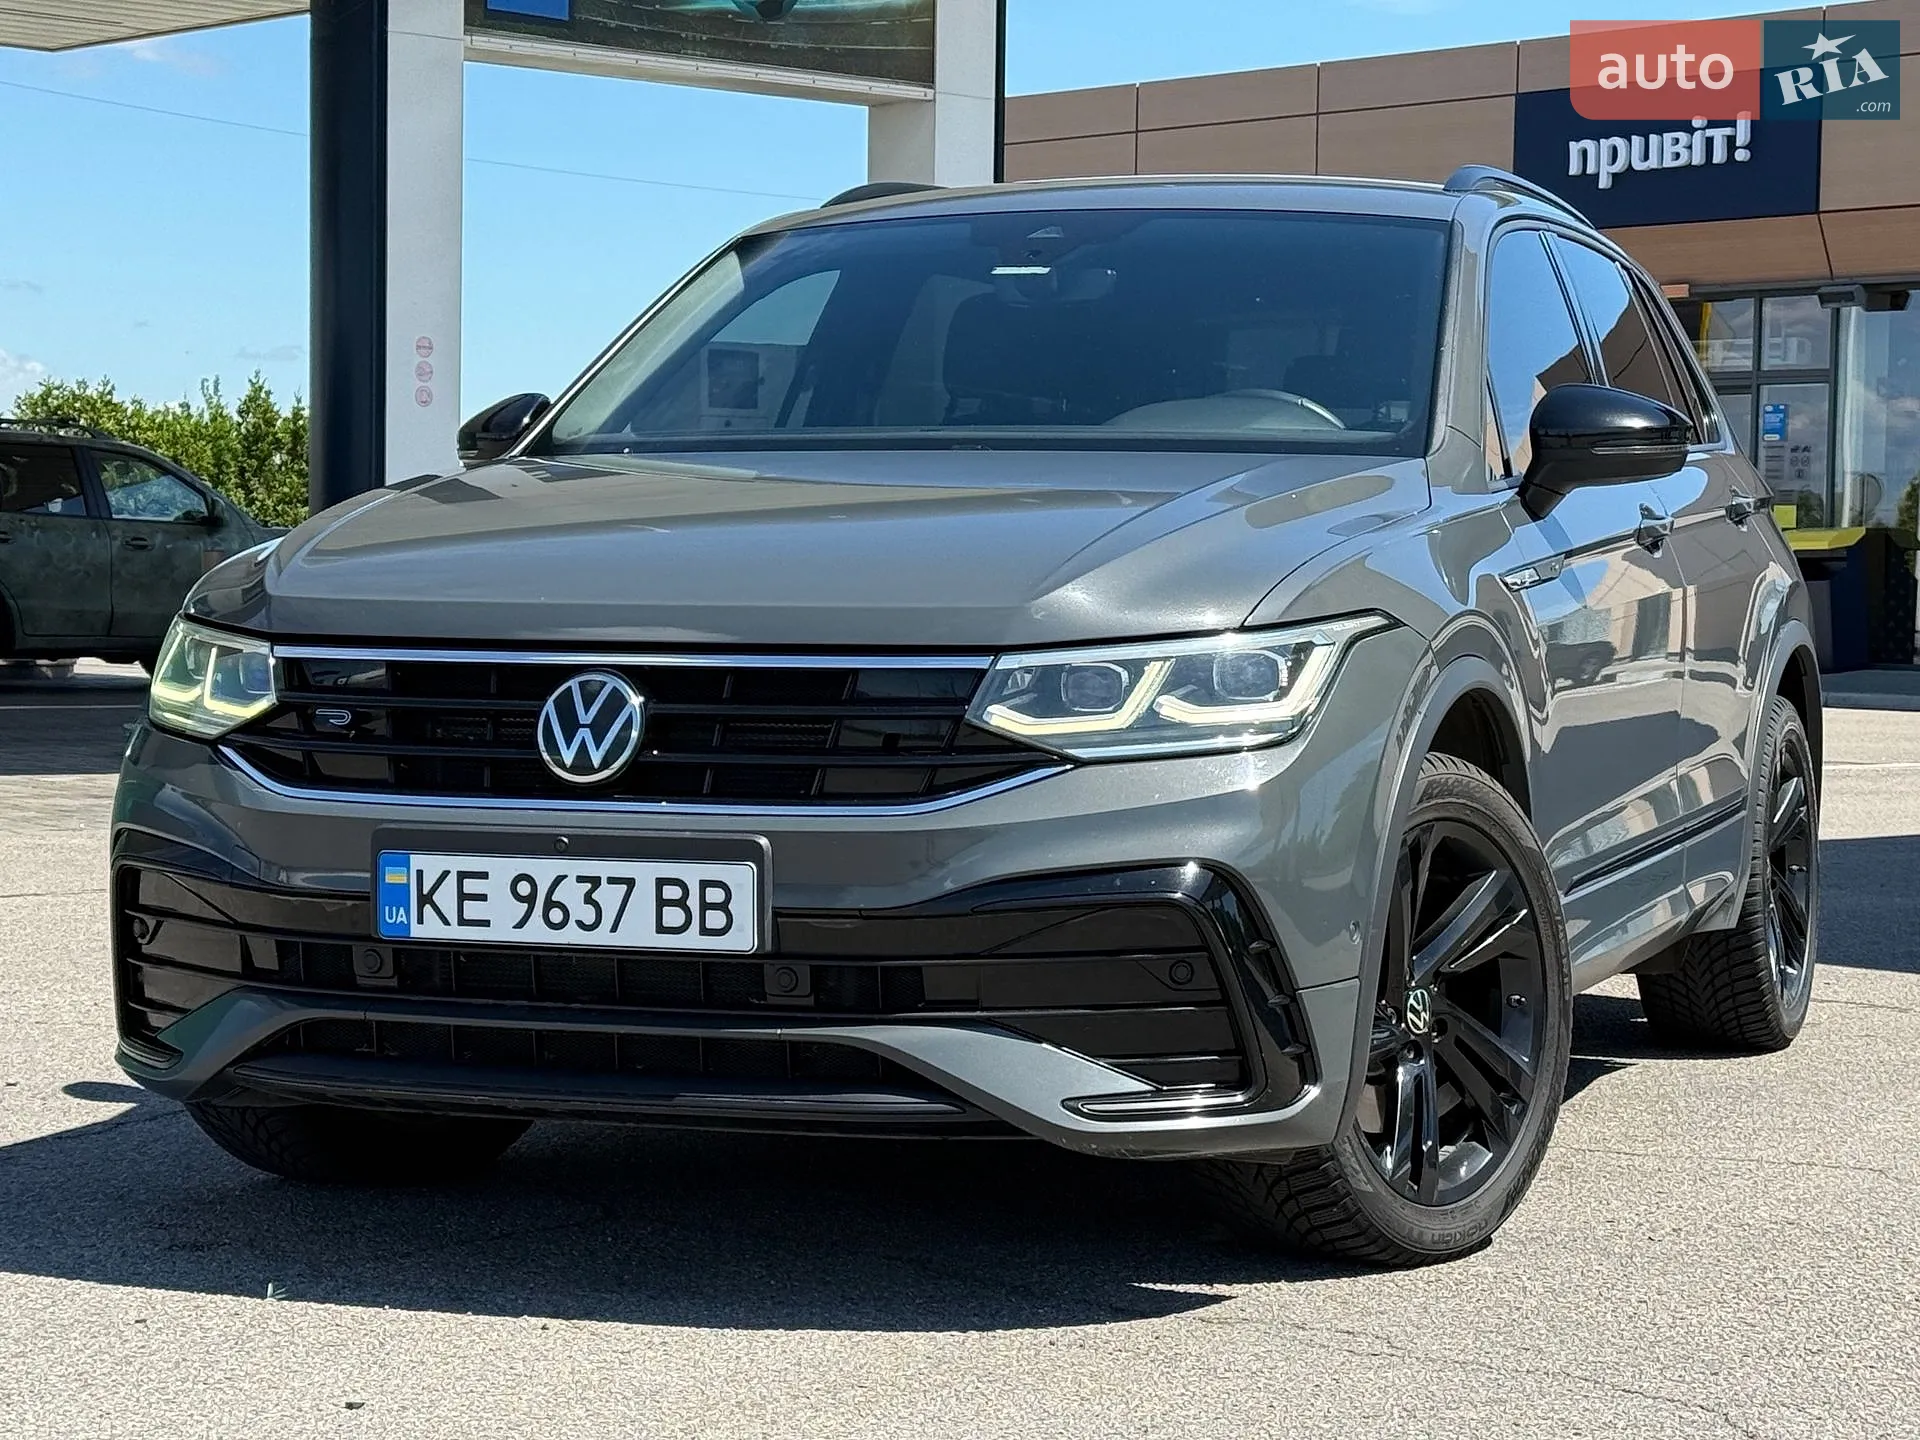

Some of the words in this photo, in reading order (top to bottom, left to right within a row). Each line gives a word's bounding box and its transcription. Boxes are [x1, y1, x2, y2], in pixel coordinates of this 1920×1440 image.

[1568, 110, 1752, 189] привіт!
[385, 906, 407, 925] UA
[415, 868, 491, 929] KE
[509, 872, 637, 934] 9637
[654, 876, 734, 937] BB
